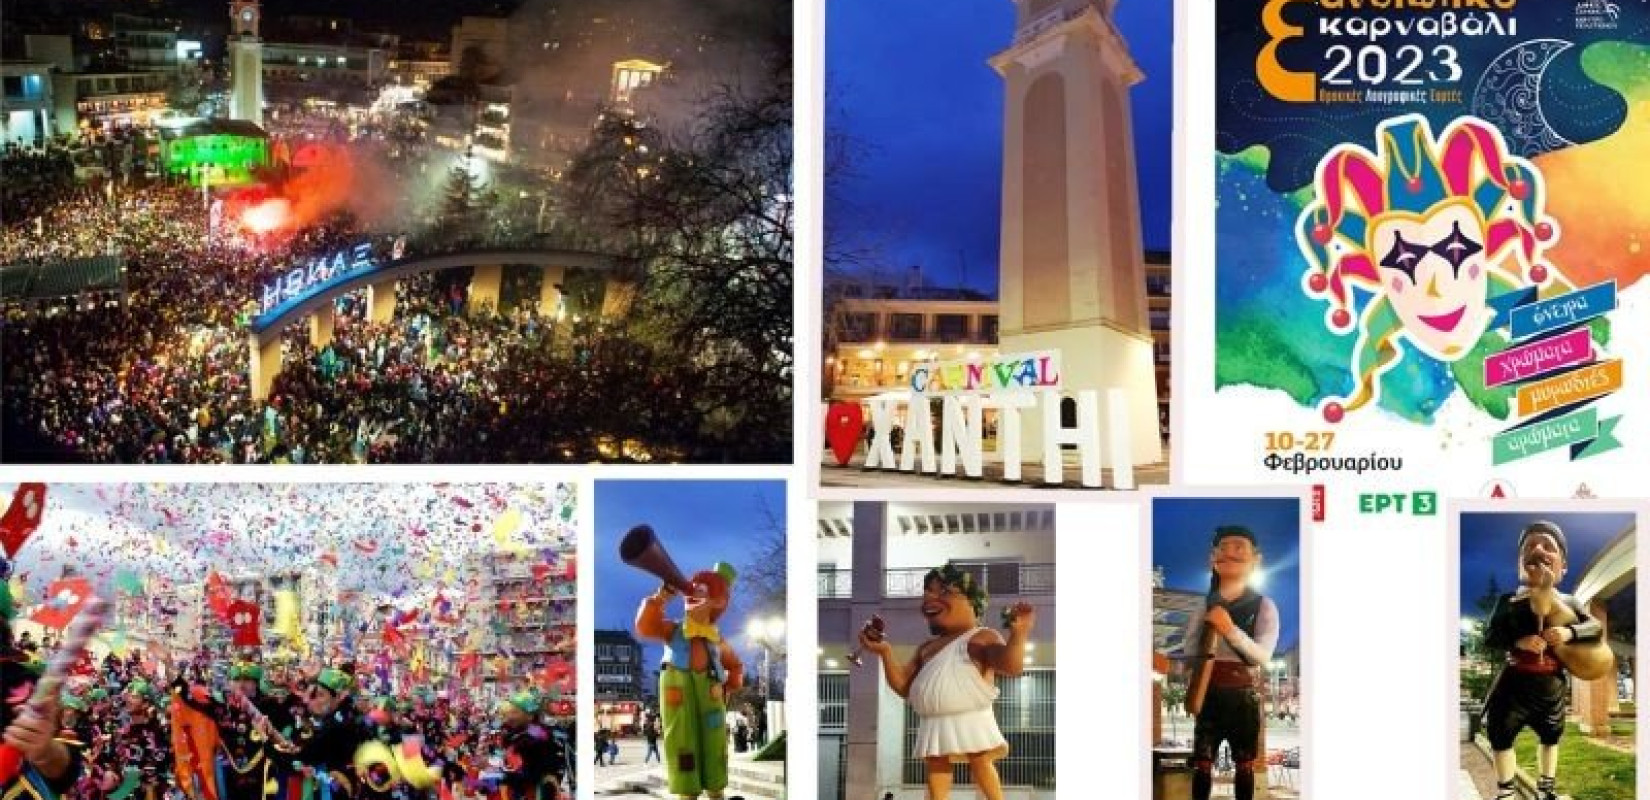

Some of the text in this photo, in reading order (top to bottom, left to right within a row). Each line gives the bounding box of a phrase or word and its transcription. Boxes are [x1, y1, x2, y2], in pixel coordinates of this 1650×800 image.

[1319, 12, 1517, 41] καρναβάλι
[1322, 44, 1464, 85] 2023
[910, 356, 1059, 392] CARNIVAL
[863, 389, 1136, 490] XANTHI
[1264, 432, 1336, 450] 10-27
[1264, 452, 1403, 474] Φεβρουαρίου
